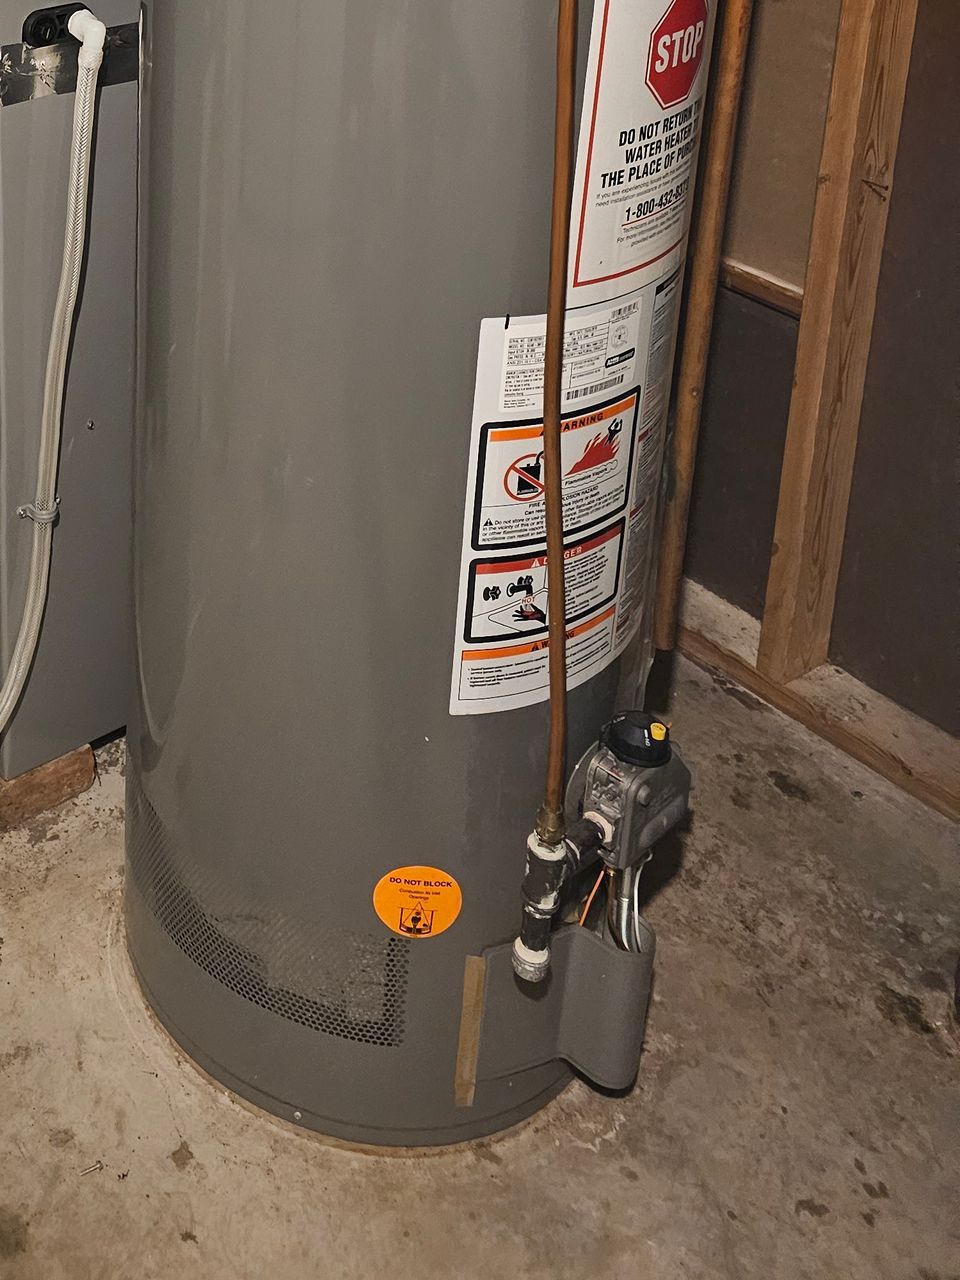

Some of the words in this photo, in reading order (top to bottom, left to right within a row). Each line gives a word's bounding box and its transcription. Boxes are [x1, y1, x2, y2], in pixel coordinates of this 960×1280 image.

[654, 20, 704, 73] STOP
[619, 129, 636, 146] DO
[639, 121, 660, 142] NOT
[625, 140, 662, 164] WATER
[601, 170, 625, 188] THE
[628, 158, 662, 182] PLACE
[664, 151, 675, 169] OF
[561, 413, 603, 432] ARNING
